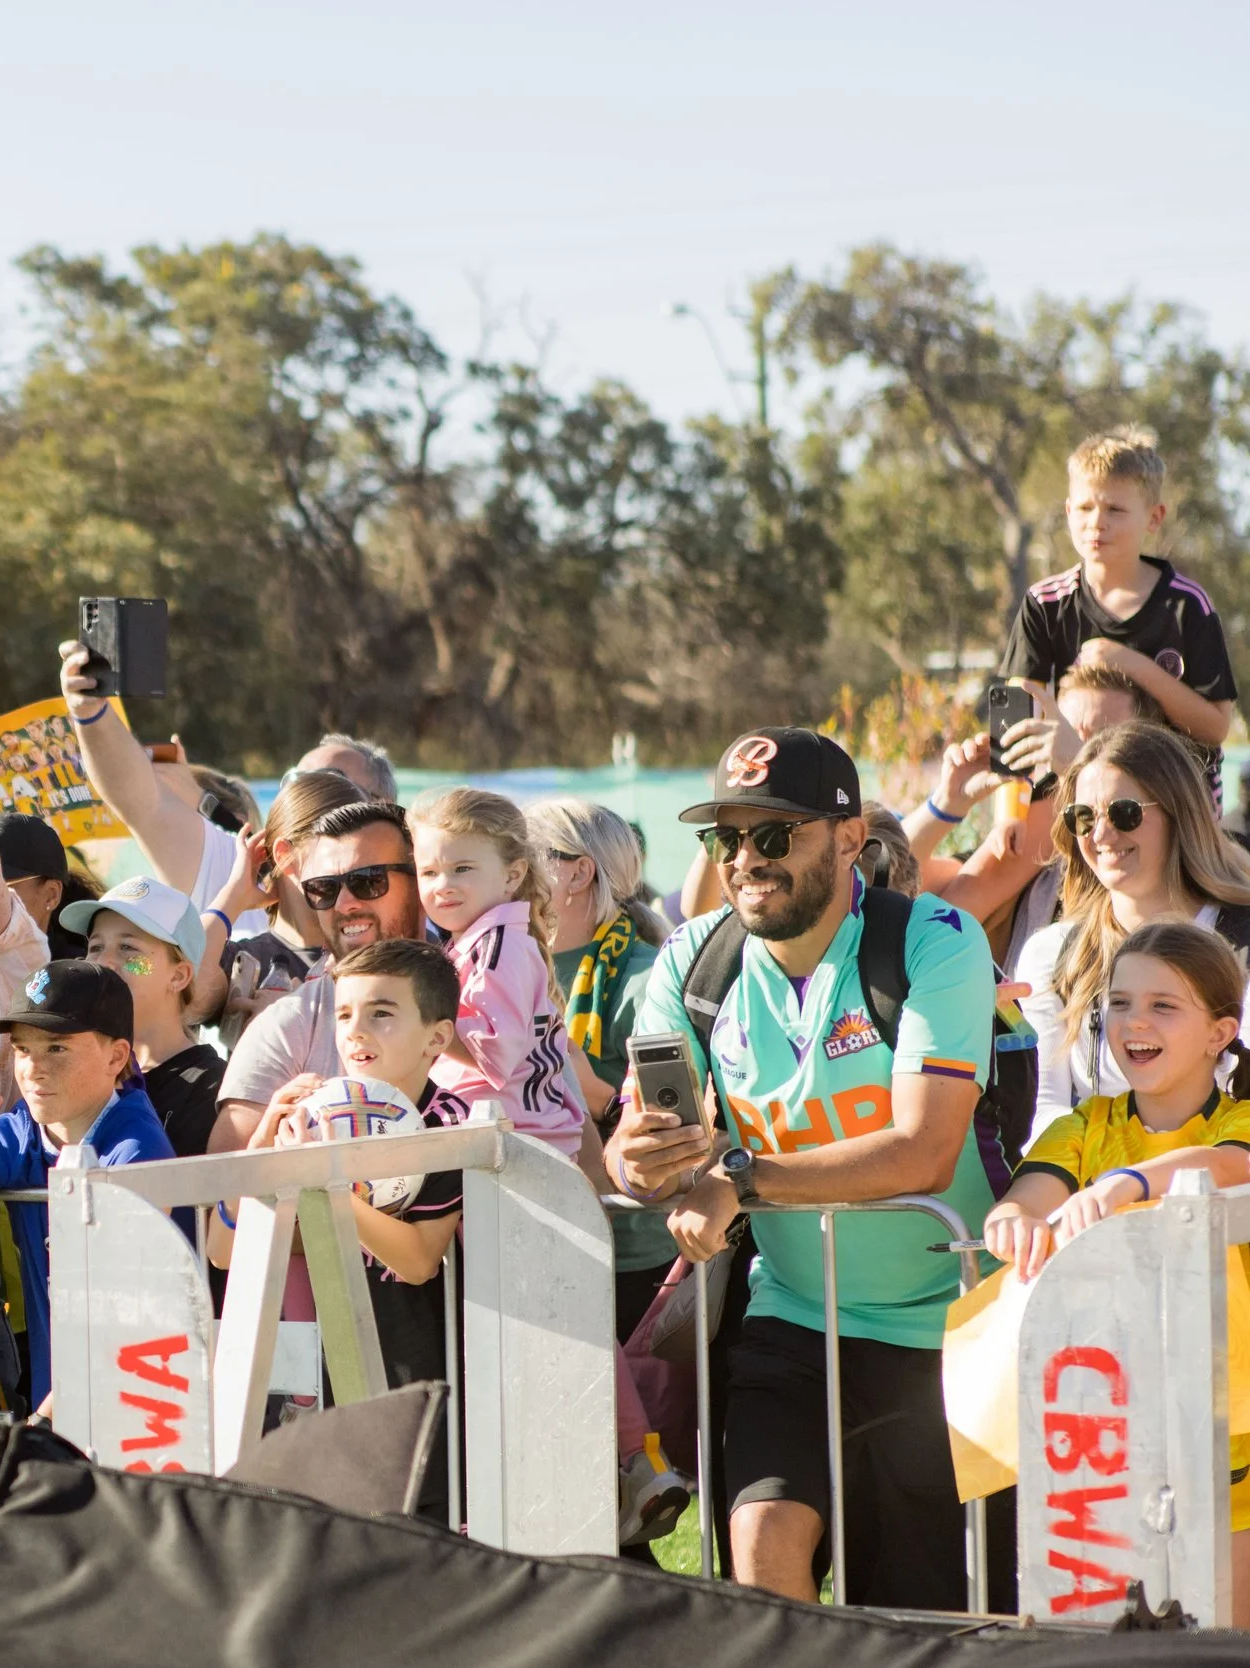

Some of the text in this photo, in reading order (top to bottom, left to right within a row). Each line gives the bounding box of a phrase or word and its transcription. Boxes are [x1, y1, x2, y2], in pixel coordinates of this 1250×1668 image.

[726, 735, 779, 788] B
[727, 1084, 893, 1156] BHP
[1043, 1346, 1132, 1615] CBWA
